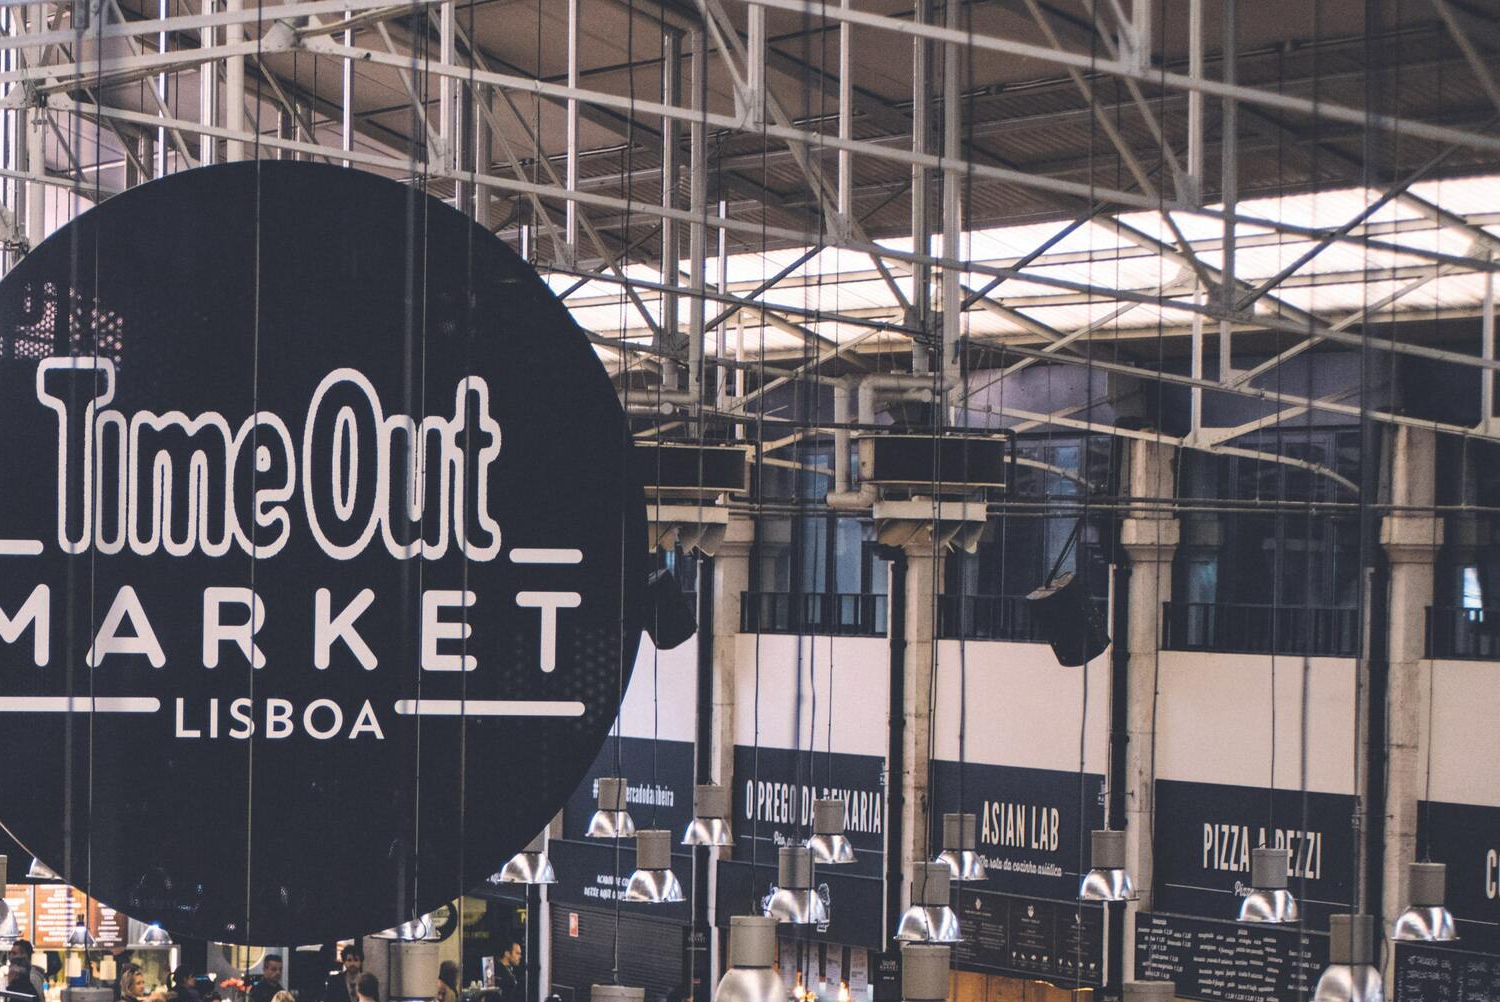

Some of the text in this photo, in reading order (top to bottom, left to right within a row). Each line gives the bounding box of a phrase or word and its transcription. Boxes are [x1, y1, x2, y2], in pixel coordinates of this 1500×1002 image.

[175, 698, 385, 740] LISBOA
[746, 779, 882, 834] O PREGO DA XARIA
[981, 800, 1060, 851] ASIAN LAB
[1203, 822, 1250, 872] PIZZA
